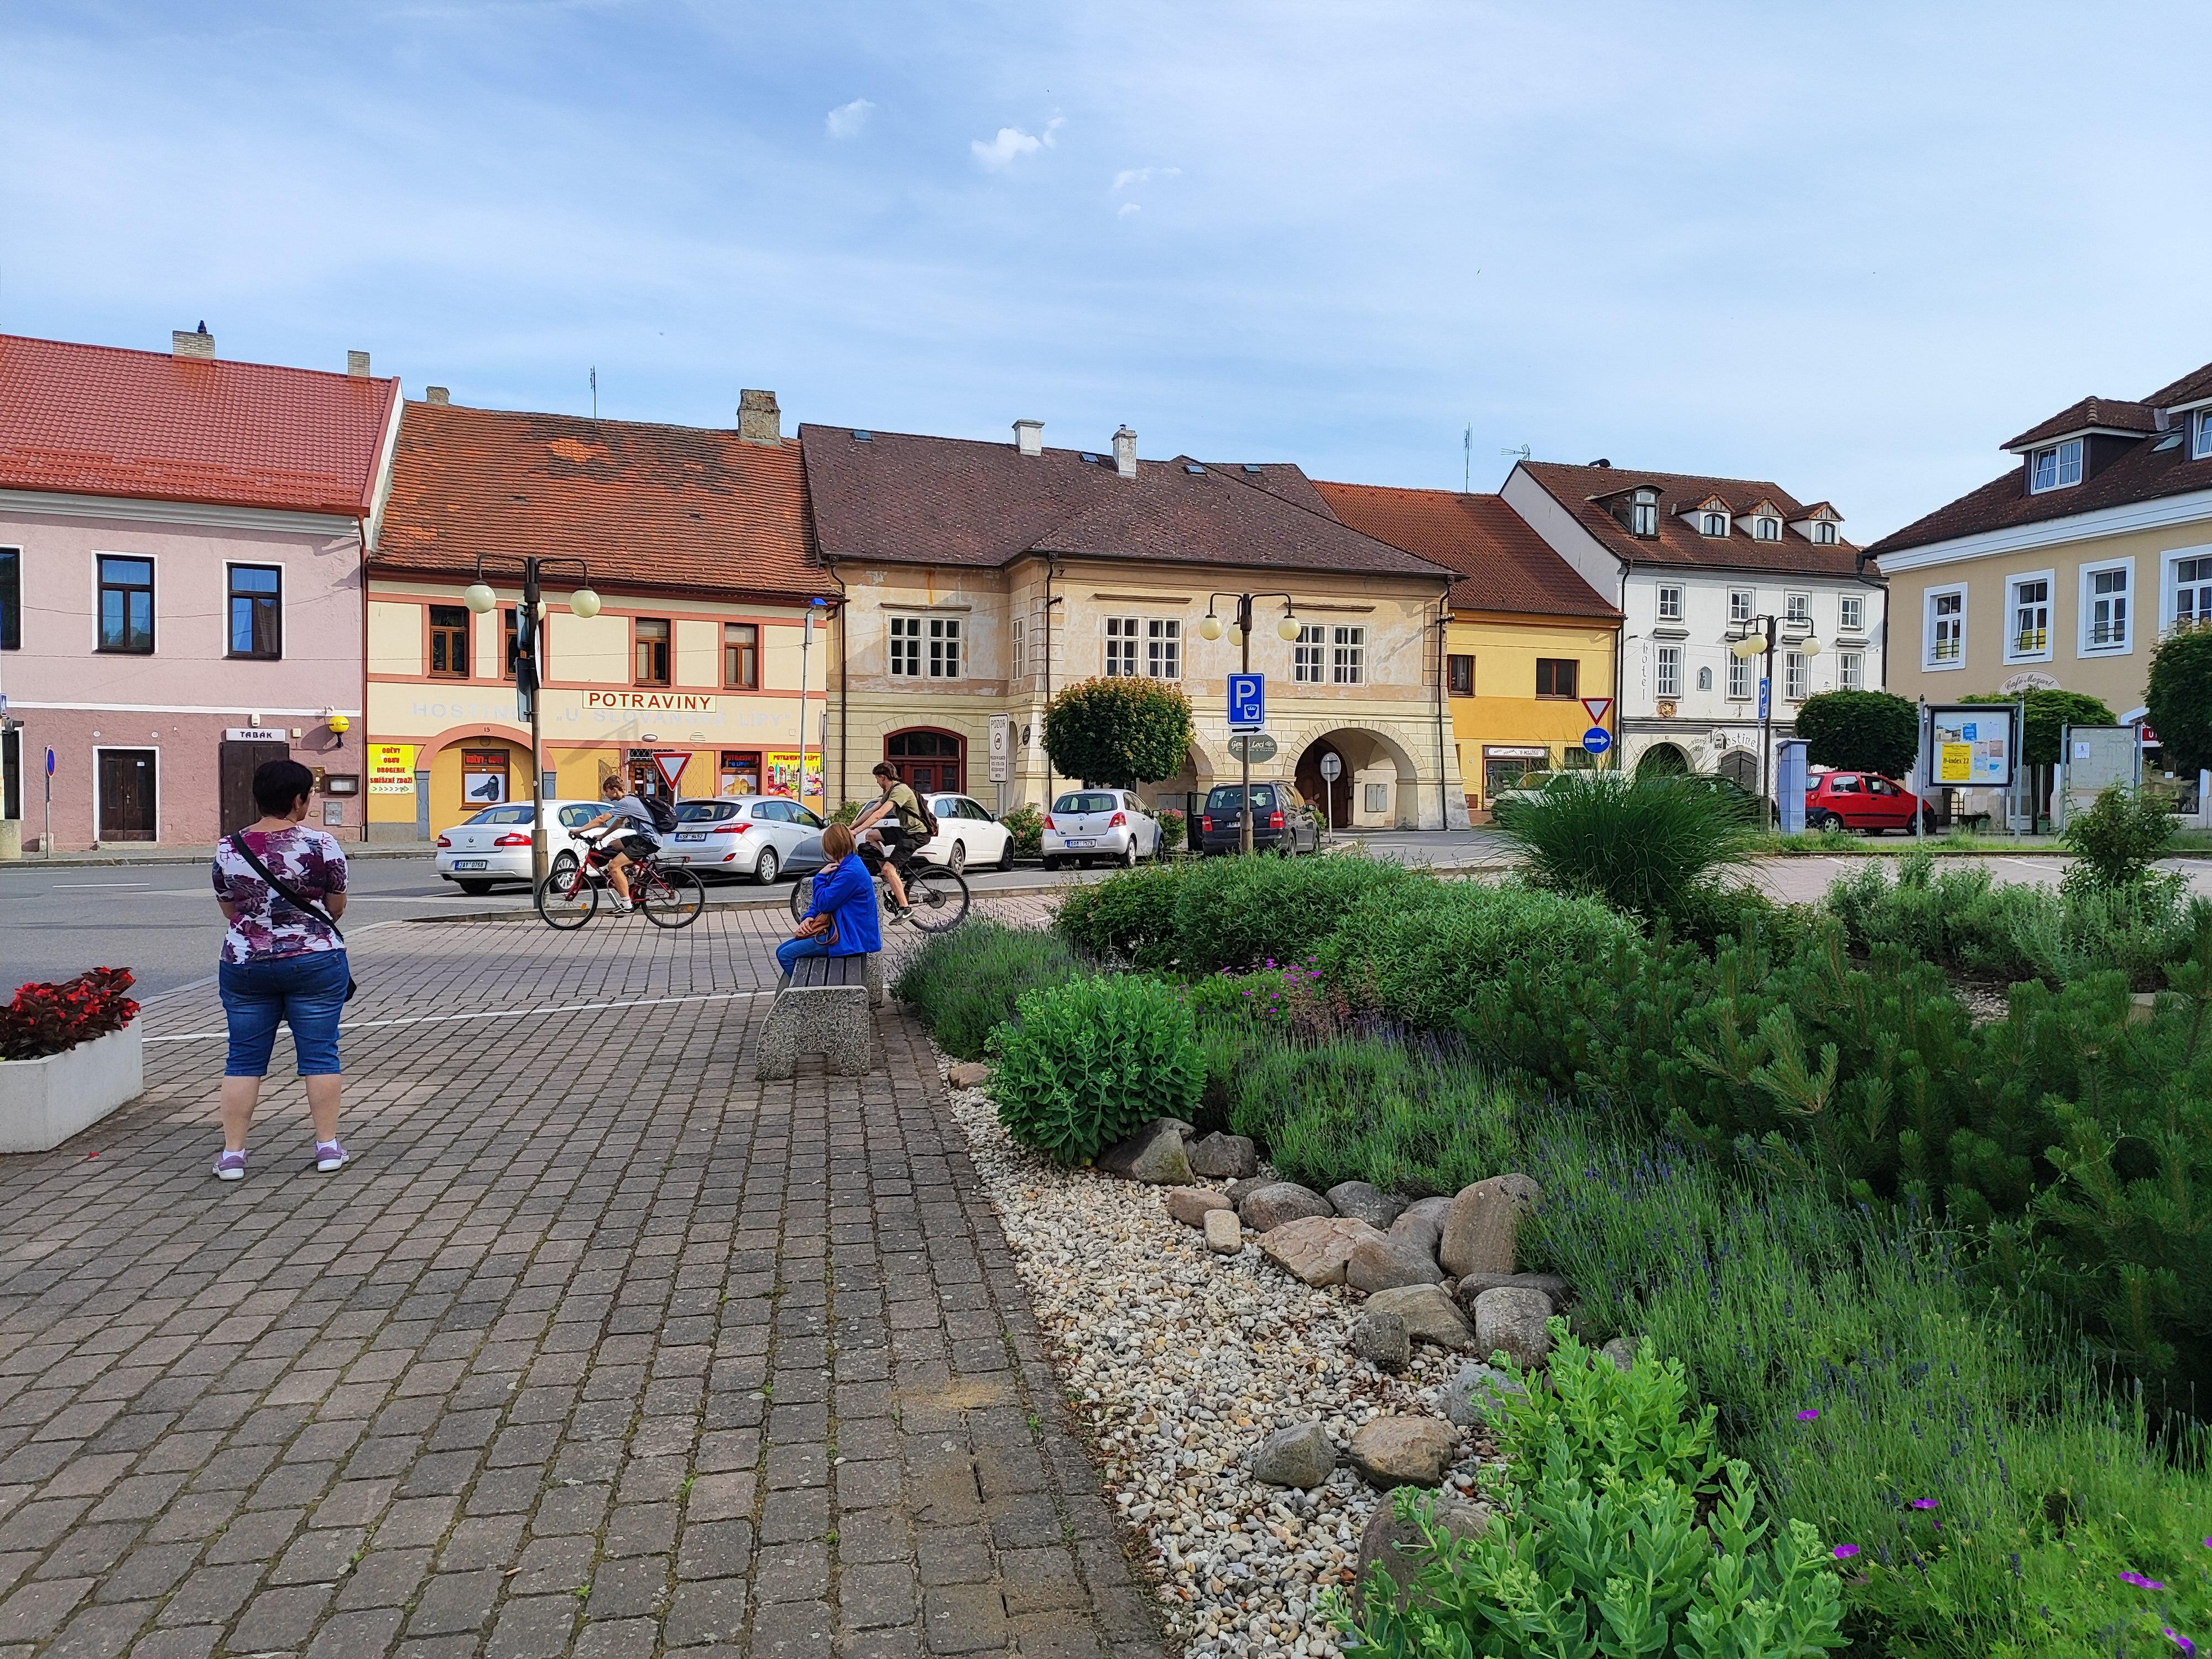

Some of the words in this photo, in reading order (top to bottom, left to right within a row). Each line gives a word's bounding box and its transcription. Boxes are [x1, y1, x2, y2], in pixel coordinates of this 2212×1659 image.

[2005, 676, 2023, 690] Café
[2023, 674, 2055, 687] Mozart
[589, 692, 711, 710] POTRAVINY
[1236, 680, 1256, 708] P
[413, 703, 519, 719] HOSTINE
[990, 719, 1006, 730] POZOR
[239, 731, 273, 739] TABÁK
